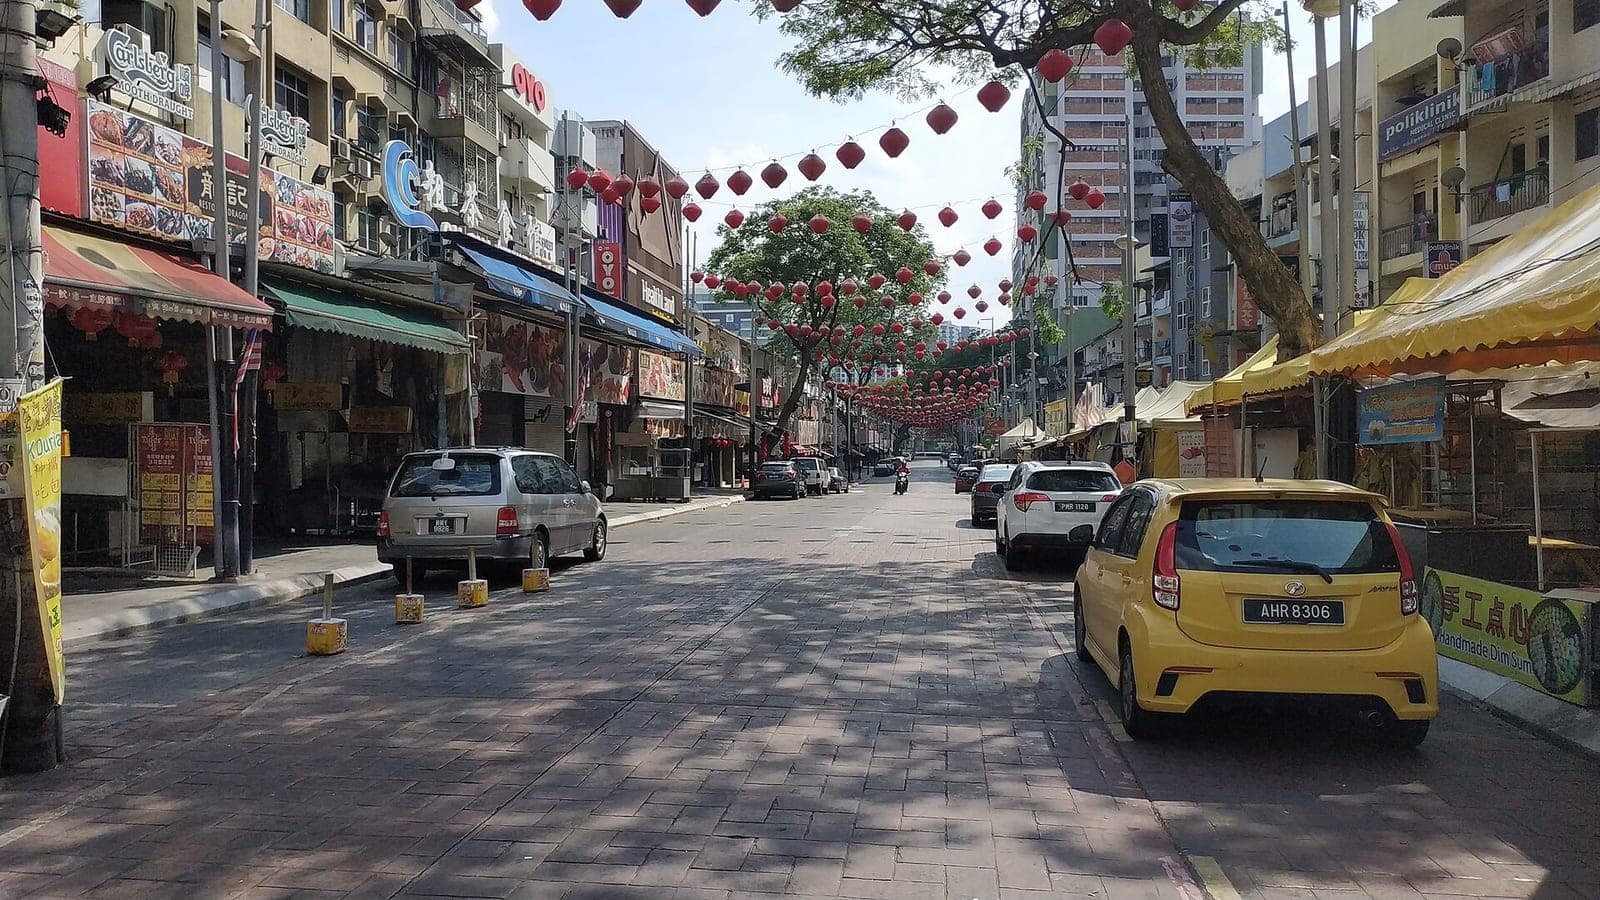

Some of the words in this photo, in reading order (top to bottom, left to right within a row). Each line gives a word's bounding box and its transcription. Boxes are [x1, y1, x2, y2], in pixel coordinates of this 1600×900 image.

[108, 29, 175, 92] Carlsberg
[116, 80, 151, 102] MOOTH
[512, 62, 545, 113] OYO
[1386, 92, 1460, 141] poliklinik
[601, 251, 615, 290] OYO
[1261, 603, 1290, 618] AHR
[1292, 604, 1331, 619] 8306
[1441, 586, 1534, 646] 手工点心
[1439, 629, 1489, 657] Handmade
[1490, 643, 1511, 666] Dim
[1511, 651, 1533, 673] Sum
